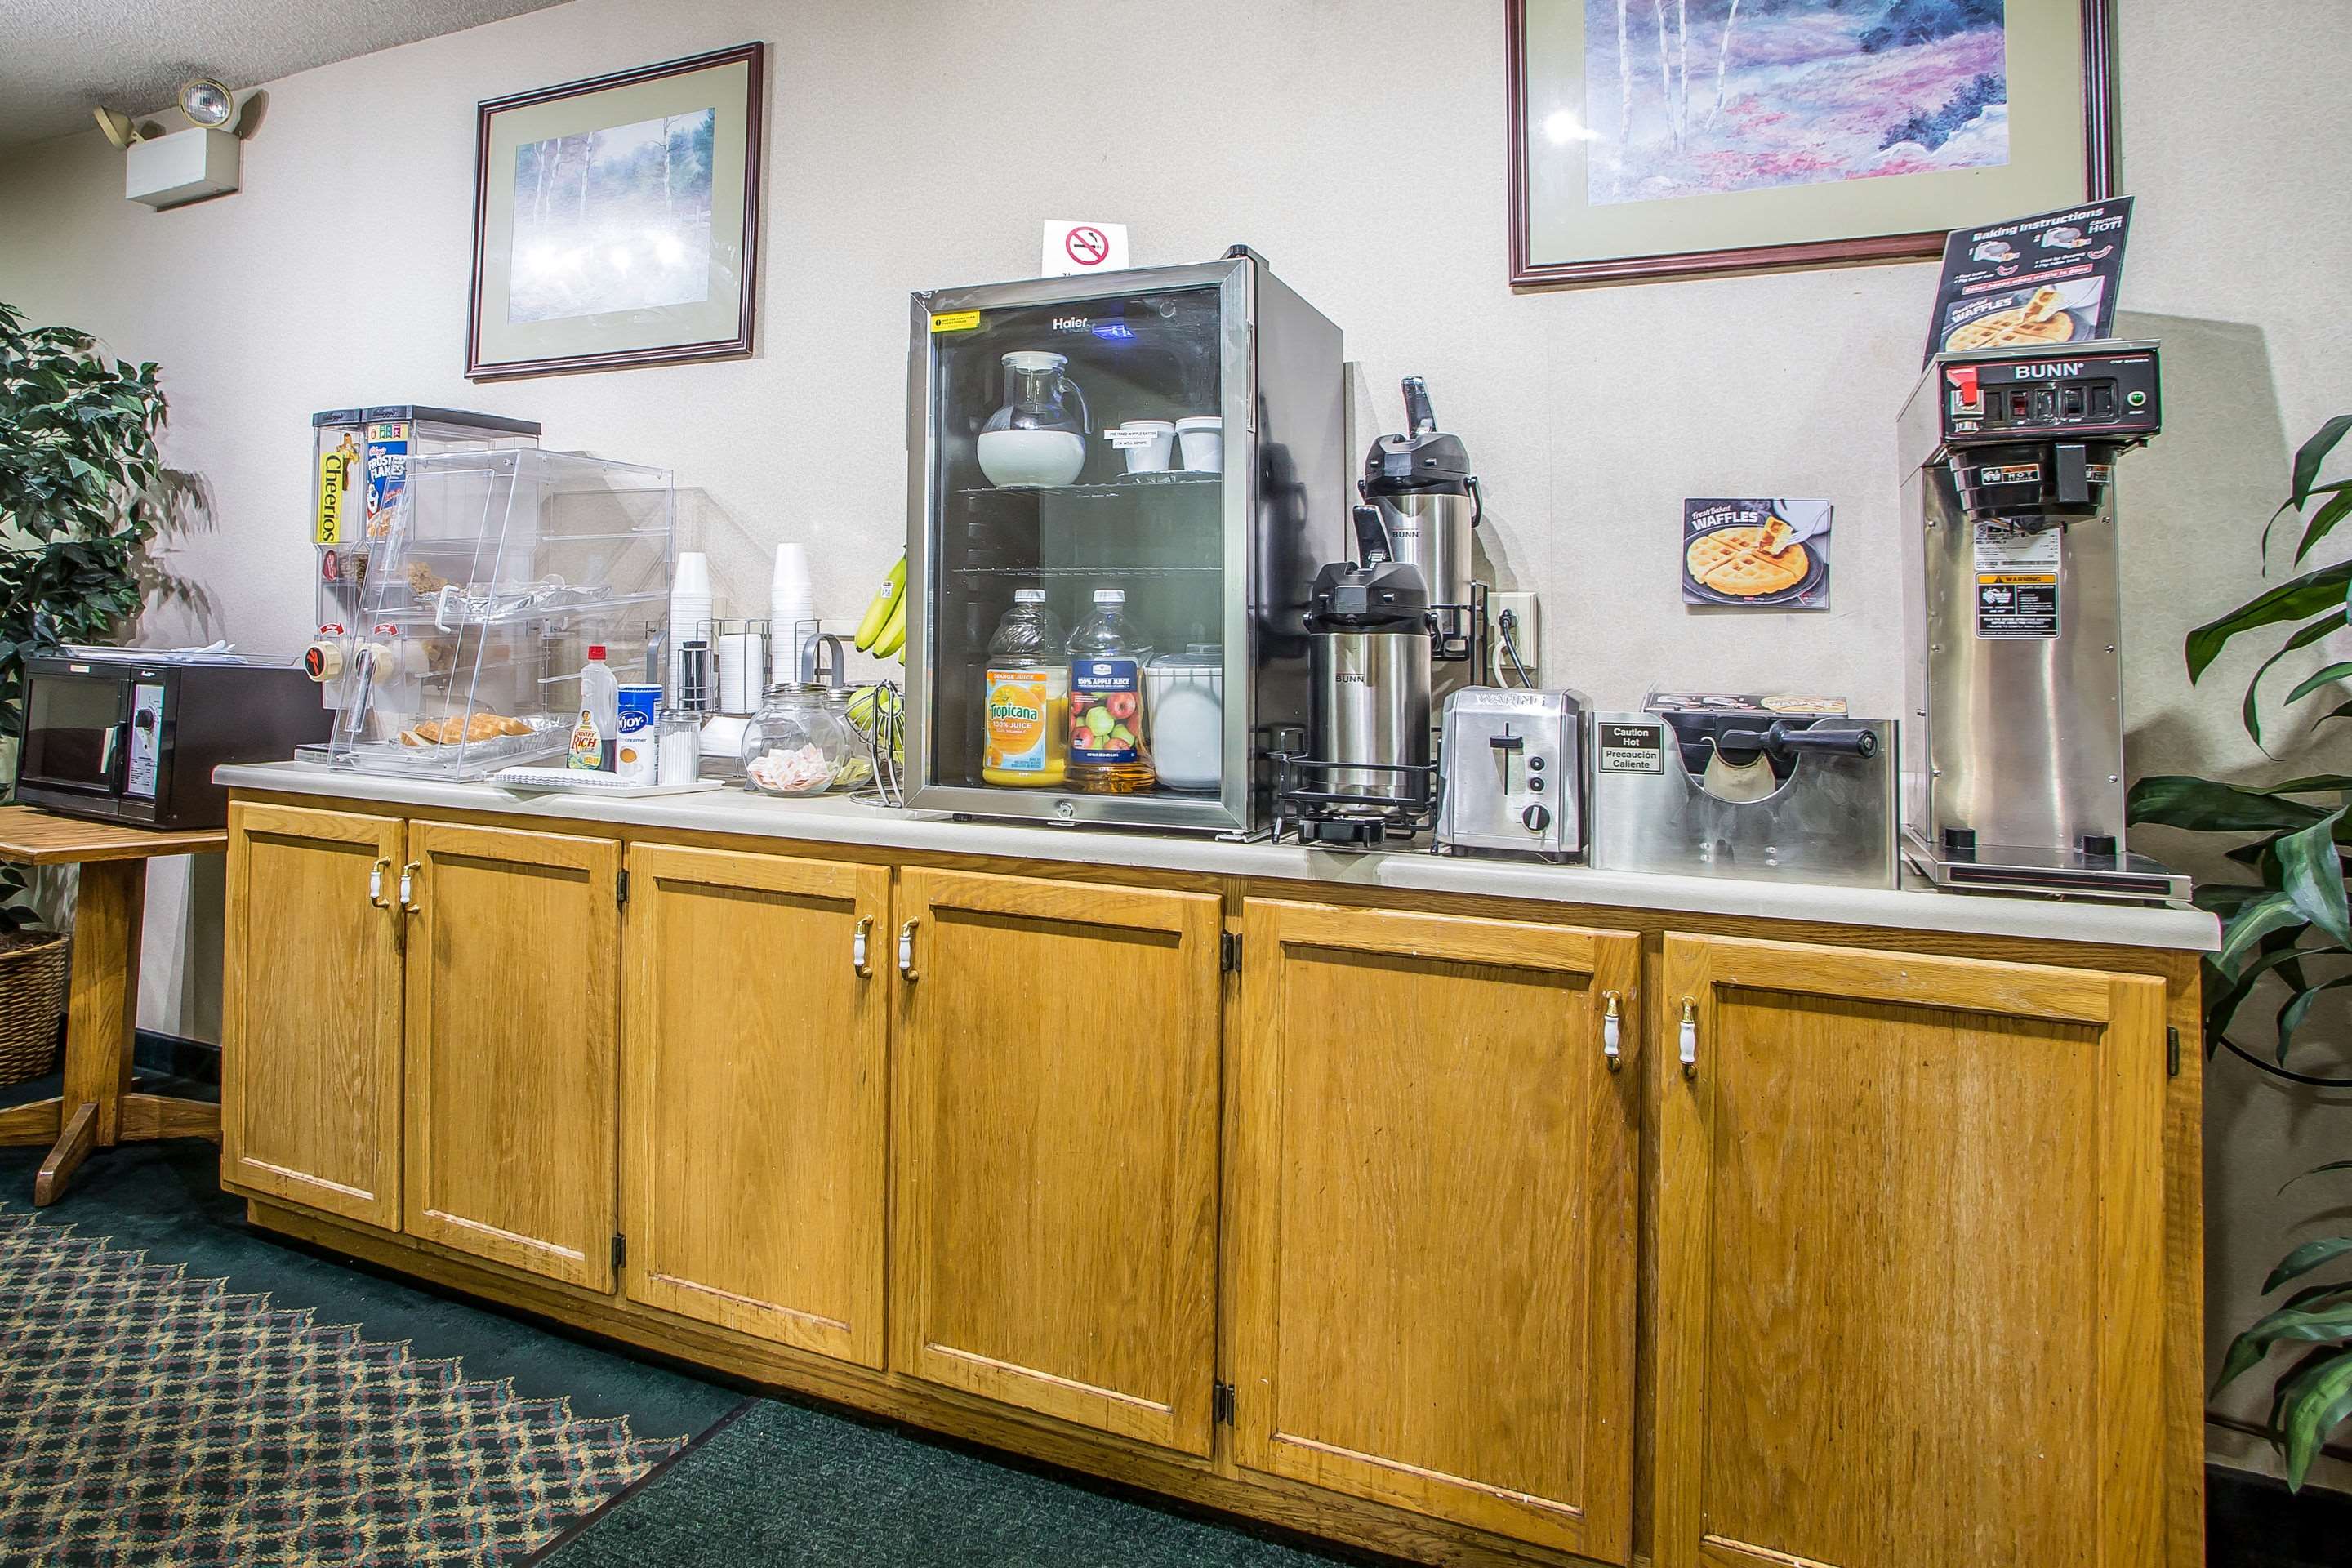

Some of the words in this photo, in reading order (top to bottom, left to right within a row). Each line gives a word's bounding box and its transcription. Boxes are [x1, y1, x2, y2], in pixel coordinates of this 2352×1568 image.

[1972, 225, 2018, 242] Baking
[2020, 207, 2105, 233] Instructions
[2088, 220, 2122, 234] HOT!
[1951, 296, 2012, 323] WAFFLES
[1053, 317, 1088, 330] Haier
[2015, 362, 2078, 380] BUNN
[371, 465, 406, 483] FLAKES
[323, 455, 342, 541] Cheerios
[1691, 510, 1758, 531] WAFFLES
[1335, 675, 1364, 683] BUNN
[990, 703, 1037, 720] Tropicana
[1613, 728, 1649, 737] Caution
[572, 736, 597, 754] RICH
[1623, 737, 1640, 746] Hot
[1606, 750, 1657, 759] Precaución
[1613, 760, 1650, 768] Caliente
